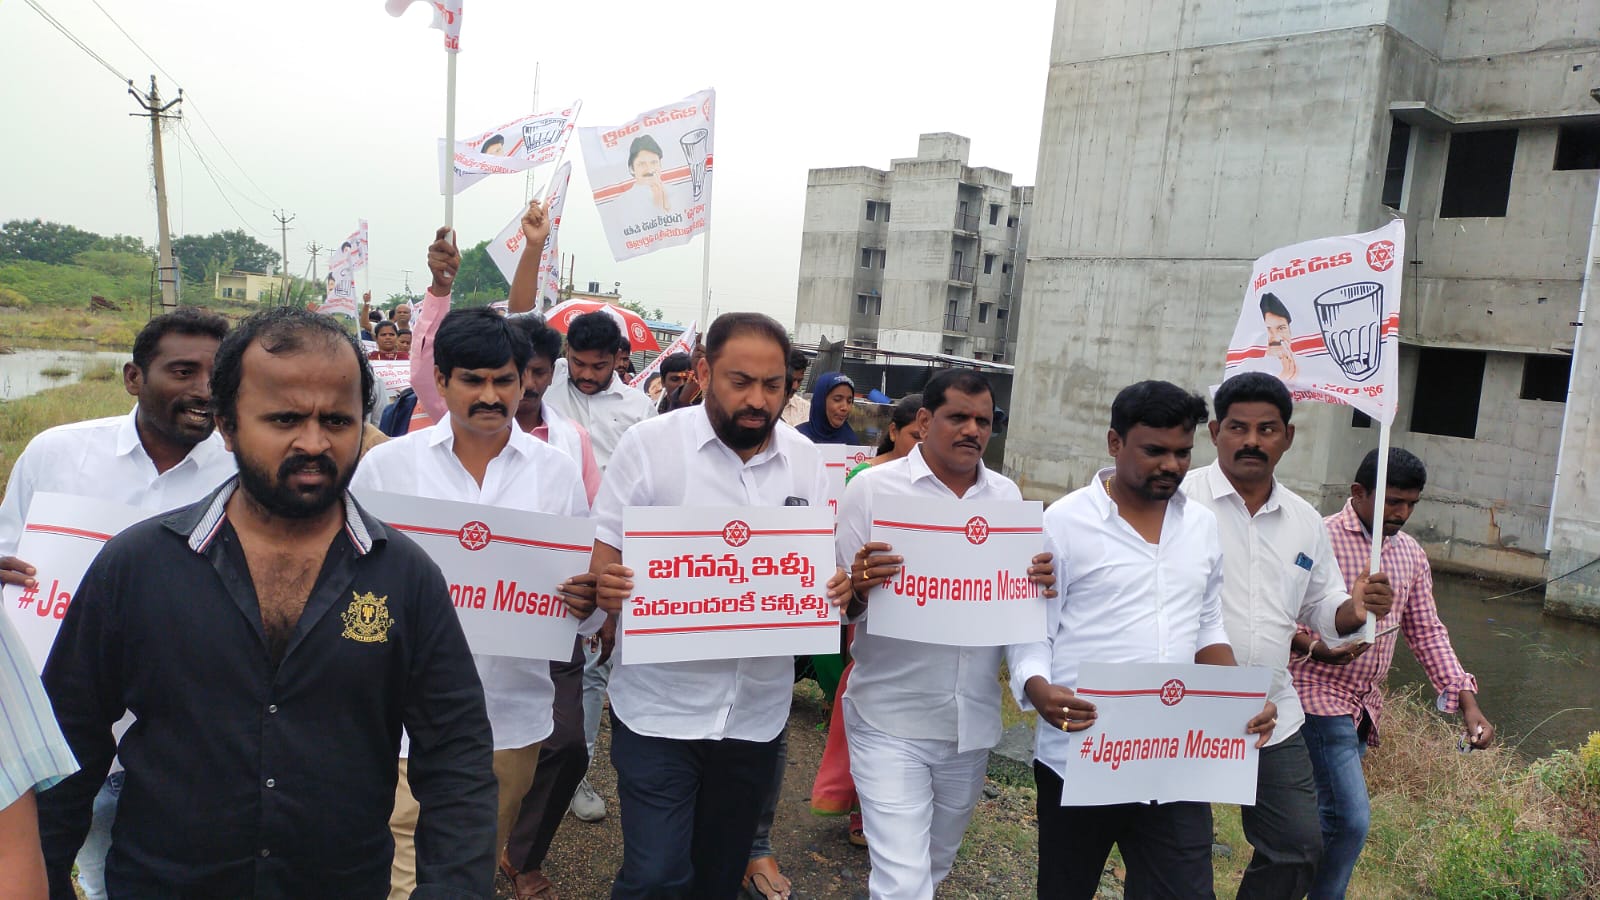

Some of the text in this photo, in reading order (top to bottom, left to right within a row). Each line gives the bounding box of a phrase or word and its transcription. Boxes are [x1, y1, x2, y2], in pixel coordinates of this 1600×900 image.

[648, 553, 749, 584] జగనన్న
[492, 579, 569, 619] Mosam
[997, 570, 1039, 600] Mosam
[630, 591, 756, 617] పేదలందరికీ
[1080, 729, 1246, 771] #Jagananna Mosam
